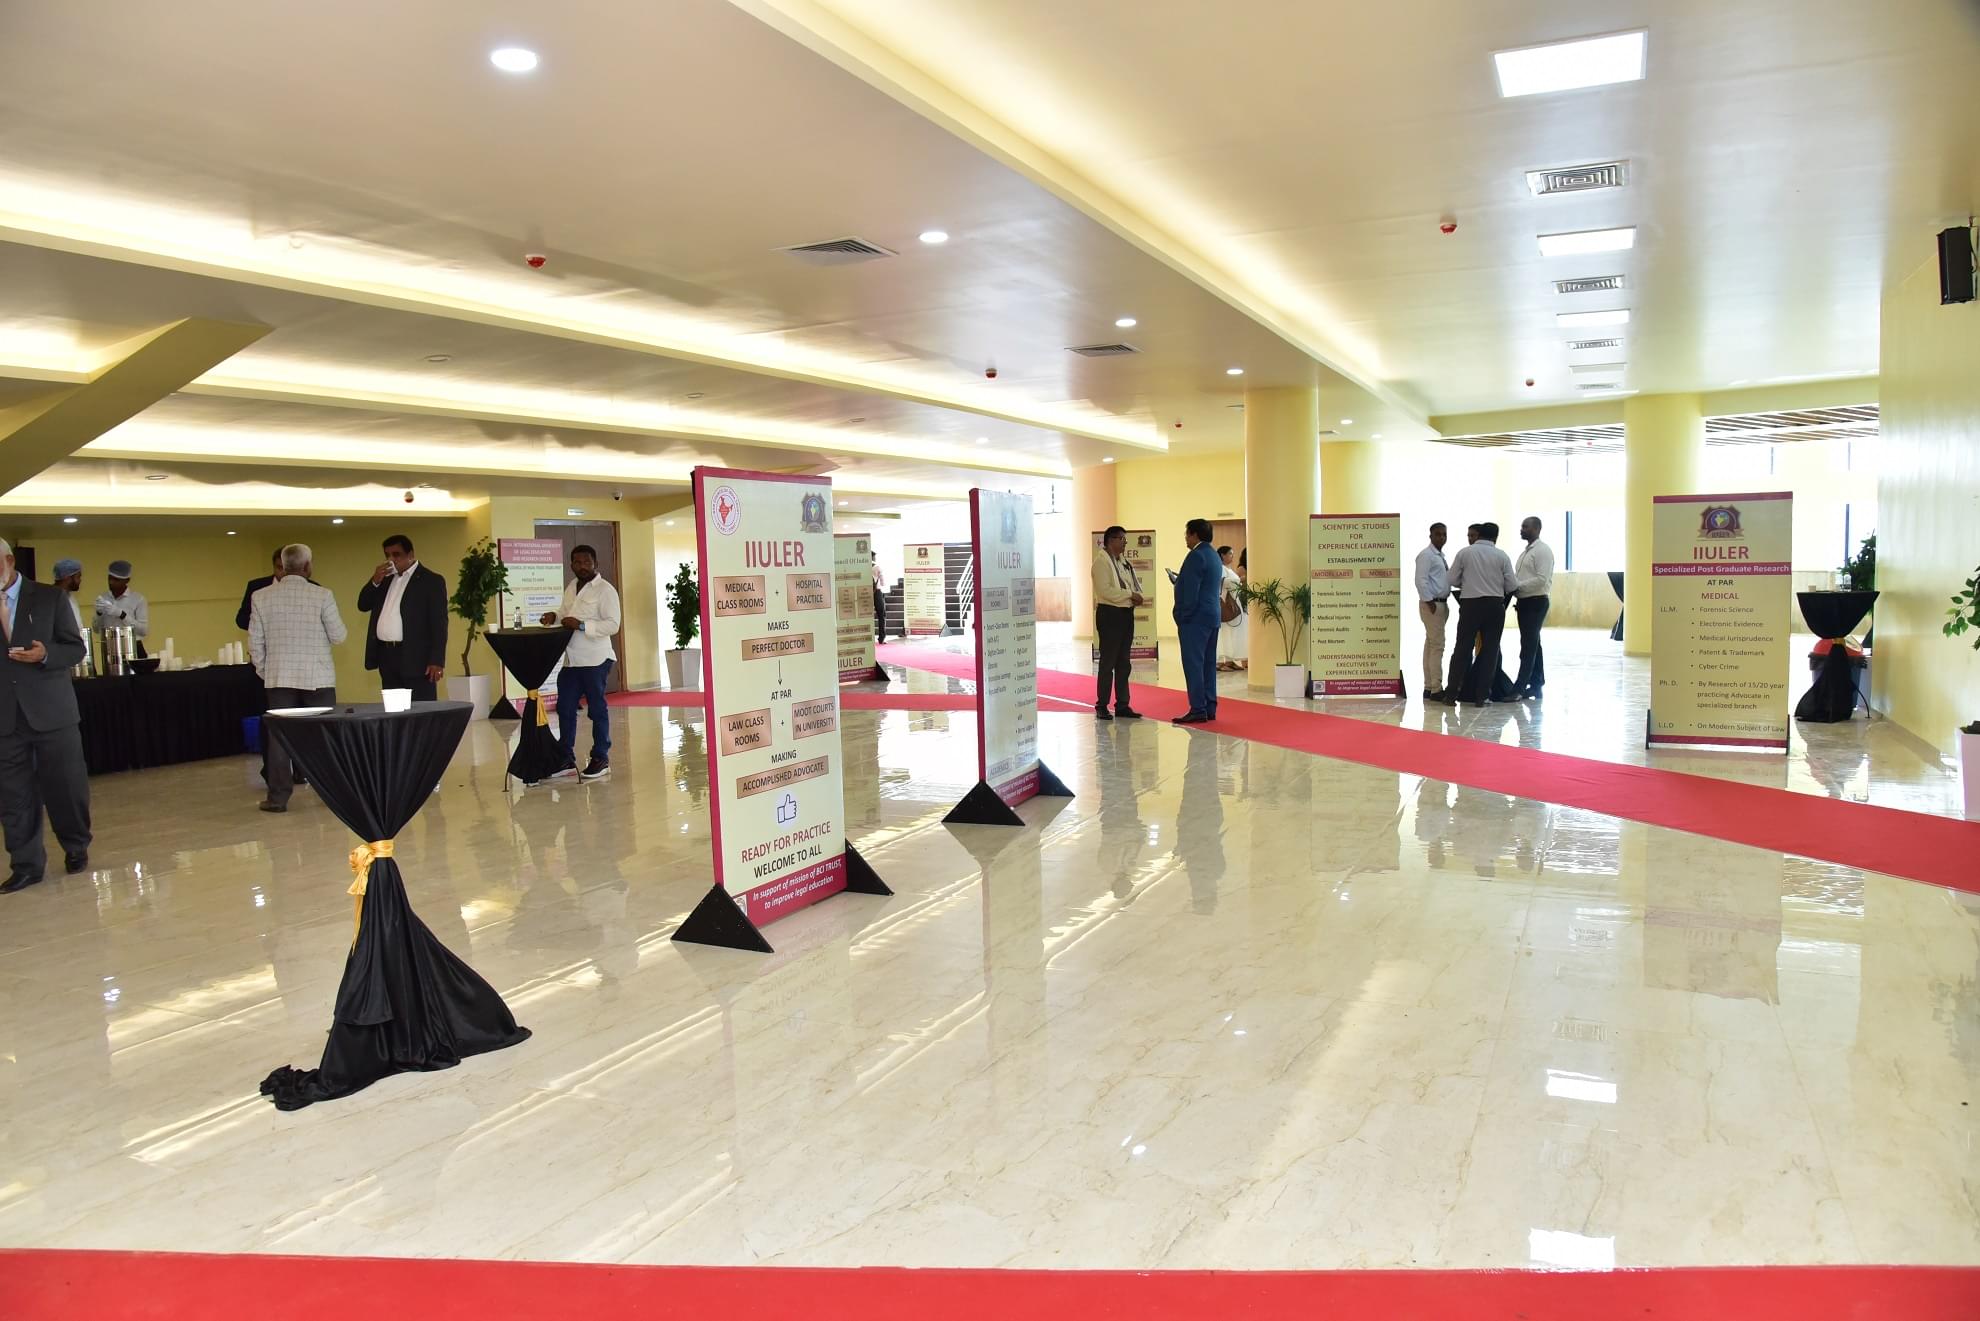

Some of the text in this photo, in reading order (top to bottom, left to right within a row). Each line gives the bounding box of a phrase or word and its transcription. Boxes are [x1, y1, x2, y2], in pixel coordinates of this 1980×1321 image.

[745, 540, 805, 568] IIULER
[998, 552, 1021, 569] IIULER
[1693, 546, 1749, 560] IIULER
[725, 582, 755, 592] MEDICAL
[796, 579, 823, 590] HOSPITAL
[717, 598, 764, 610] CLASS ROOMS
[796, 594, 824, 605] PRACTICE
[768, 621, 789, 631] MAKES
[752, 639, 805, 653] PERFECT DOCTOR
[771, 689, 792, 701] AT PAR
[794, 701, 834, 718] MOOT COURTS
[728, 716, 764, 732] LAW CLASS
[795, 716, 834, 732] IN UNIVERSITY
[1737, 724, 1762, 732] Subject
[734, 733, 760, 747] ROOMS
[771, 749, 797, 764] MAKING
[743, 761, 824, 792] ACCOMPLISHED ADVOCATE
[742, 820, 832, 864] READY FOR PRACTICE
[754, 844, 823, 879] WELCOME TO ALL
[753, 858, 843, 901] In support of mission of BCI TRUST,
[764, 874, 834, 910] to improve legal education
